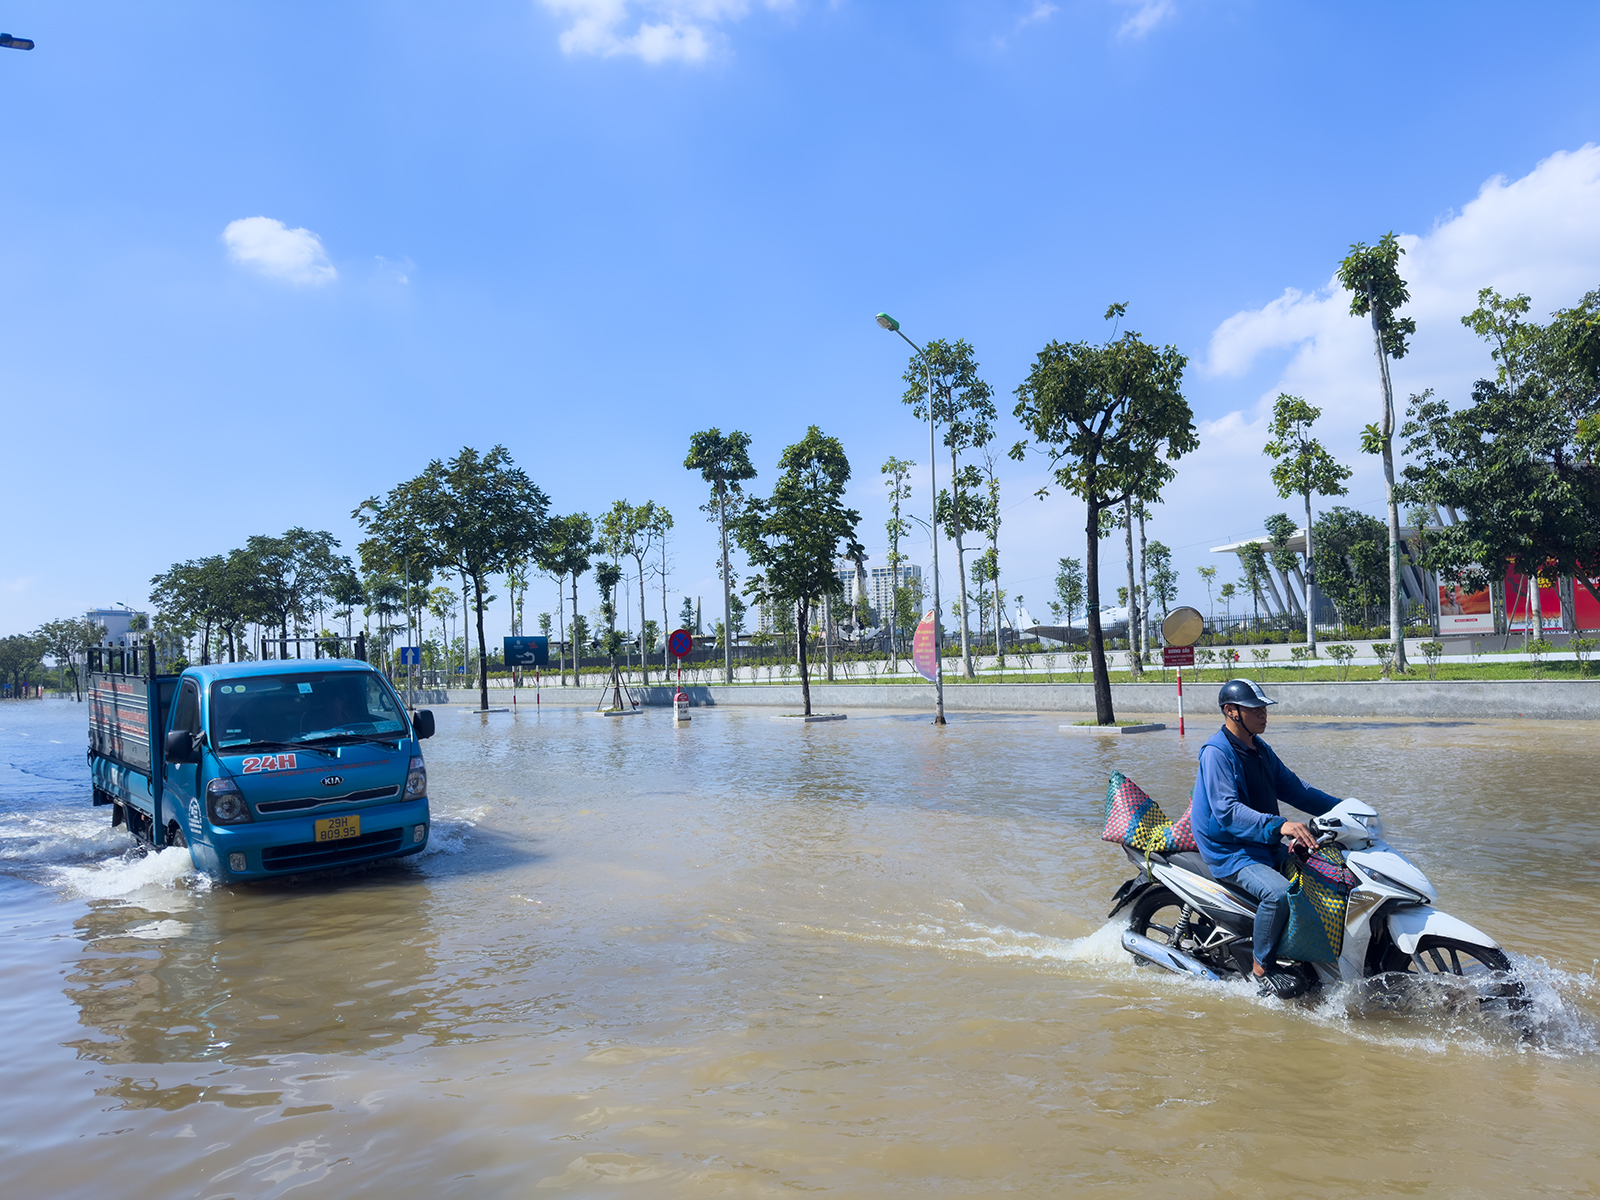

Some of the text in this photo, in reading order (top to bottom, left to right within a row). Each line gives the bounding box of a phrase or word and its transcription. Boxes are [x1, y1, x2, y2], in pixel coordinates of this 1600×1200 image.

[242, 754, 297, 774] 24H
[323, 776, 342, 786] KIA
[328, 817, 348, 829] 29H
[320, 826, 356, 840] 809.95
[1353, 893, 1375, 901] HONDA
